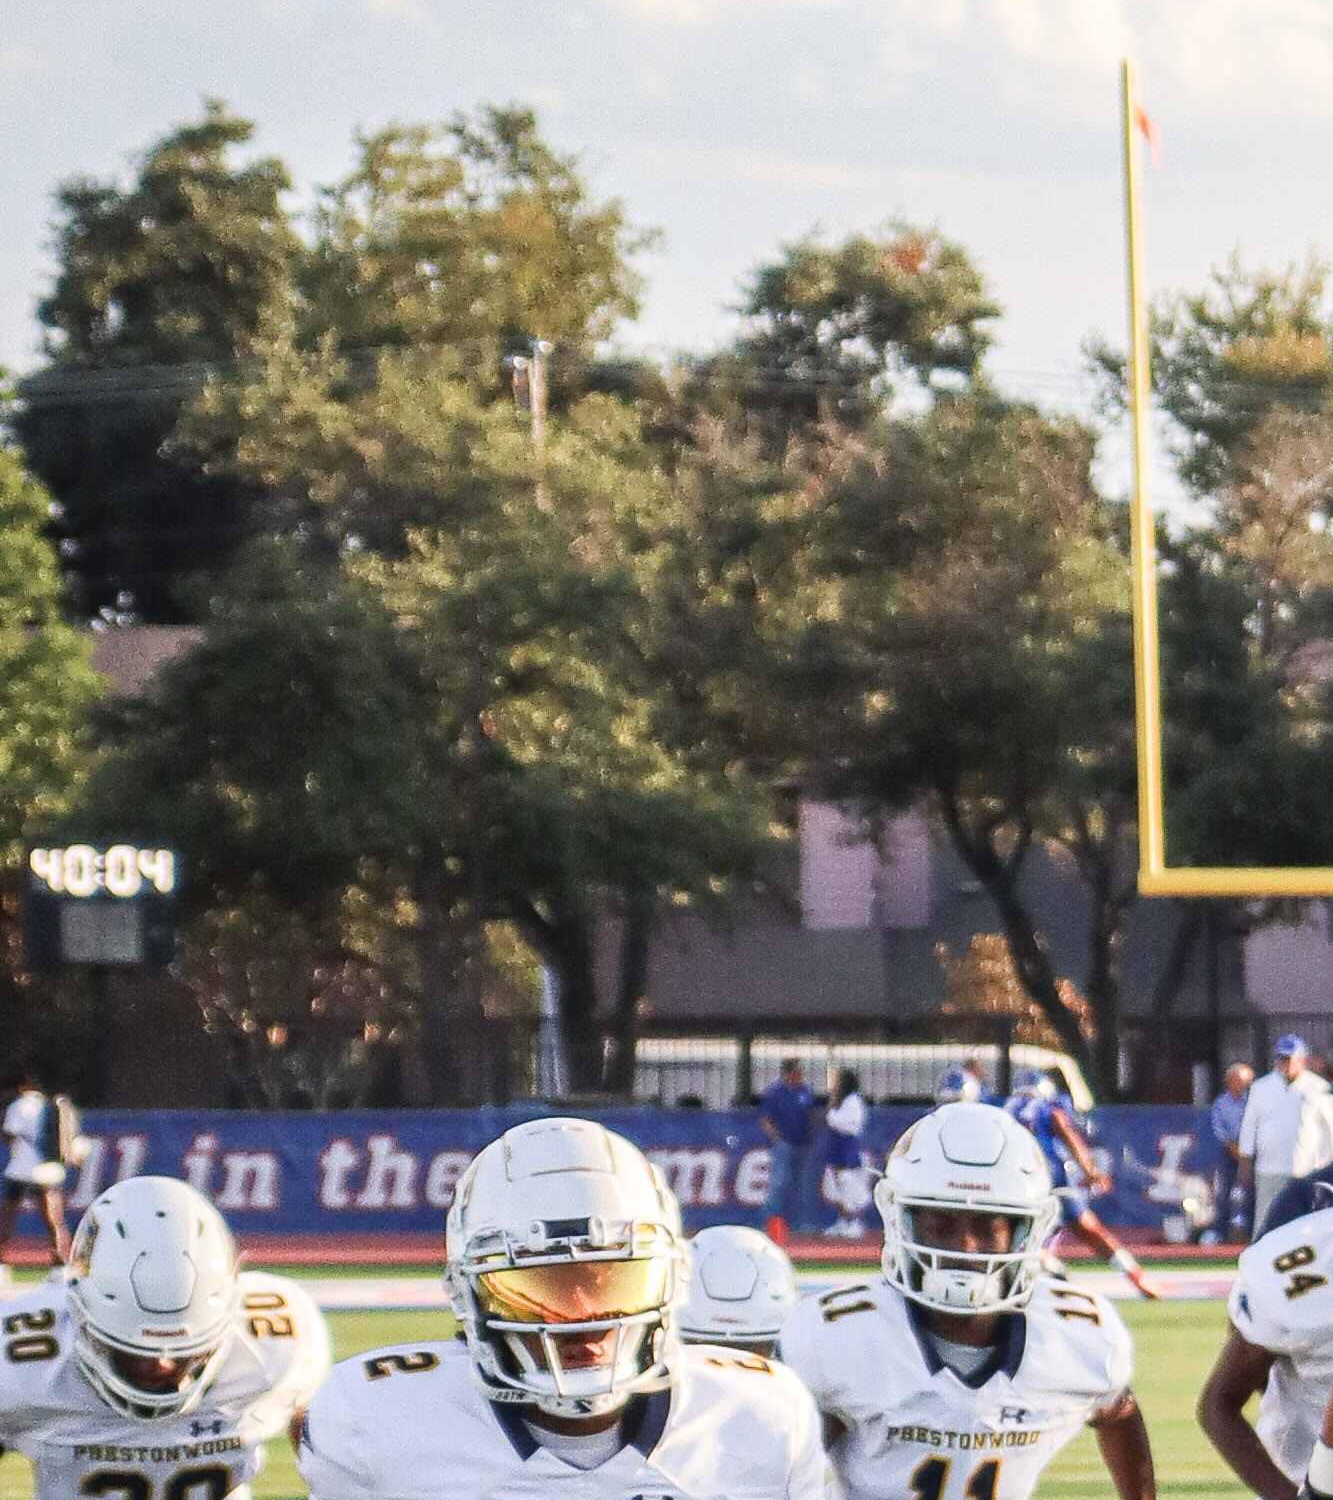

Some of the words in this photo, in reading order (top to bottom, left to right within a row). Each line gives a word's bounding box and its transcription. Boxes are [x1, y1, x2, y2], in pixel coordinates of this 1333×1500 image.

[30, 844, 174, 897] 40:04
[180, 1131, 280, 1212] in
[317, 1130, 478, 1212] the
[1272, 1244, 1330, 1301] 84
[3, 1308, 60, 1364] 20
[364, 1350, 441, 1382] 2
[886, 1425, 1042, 1450] PRESTONWOOD
